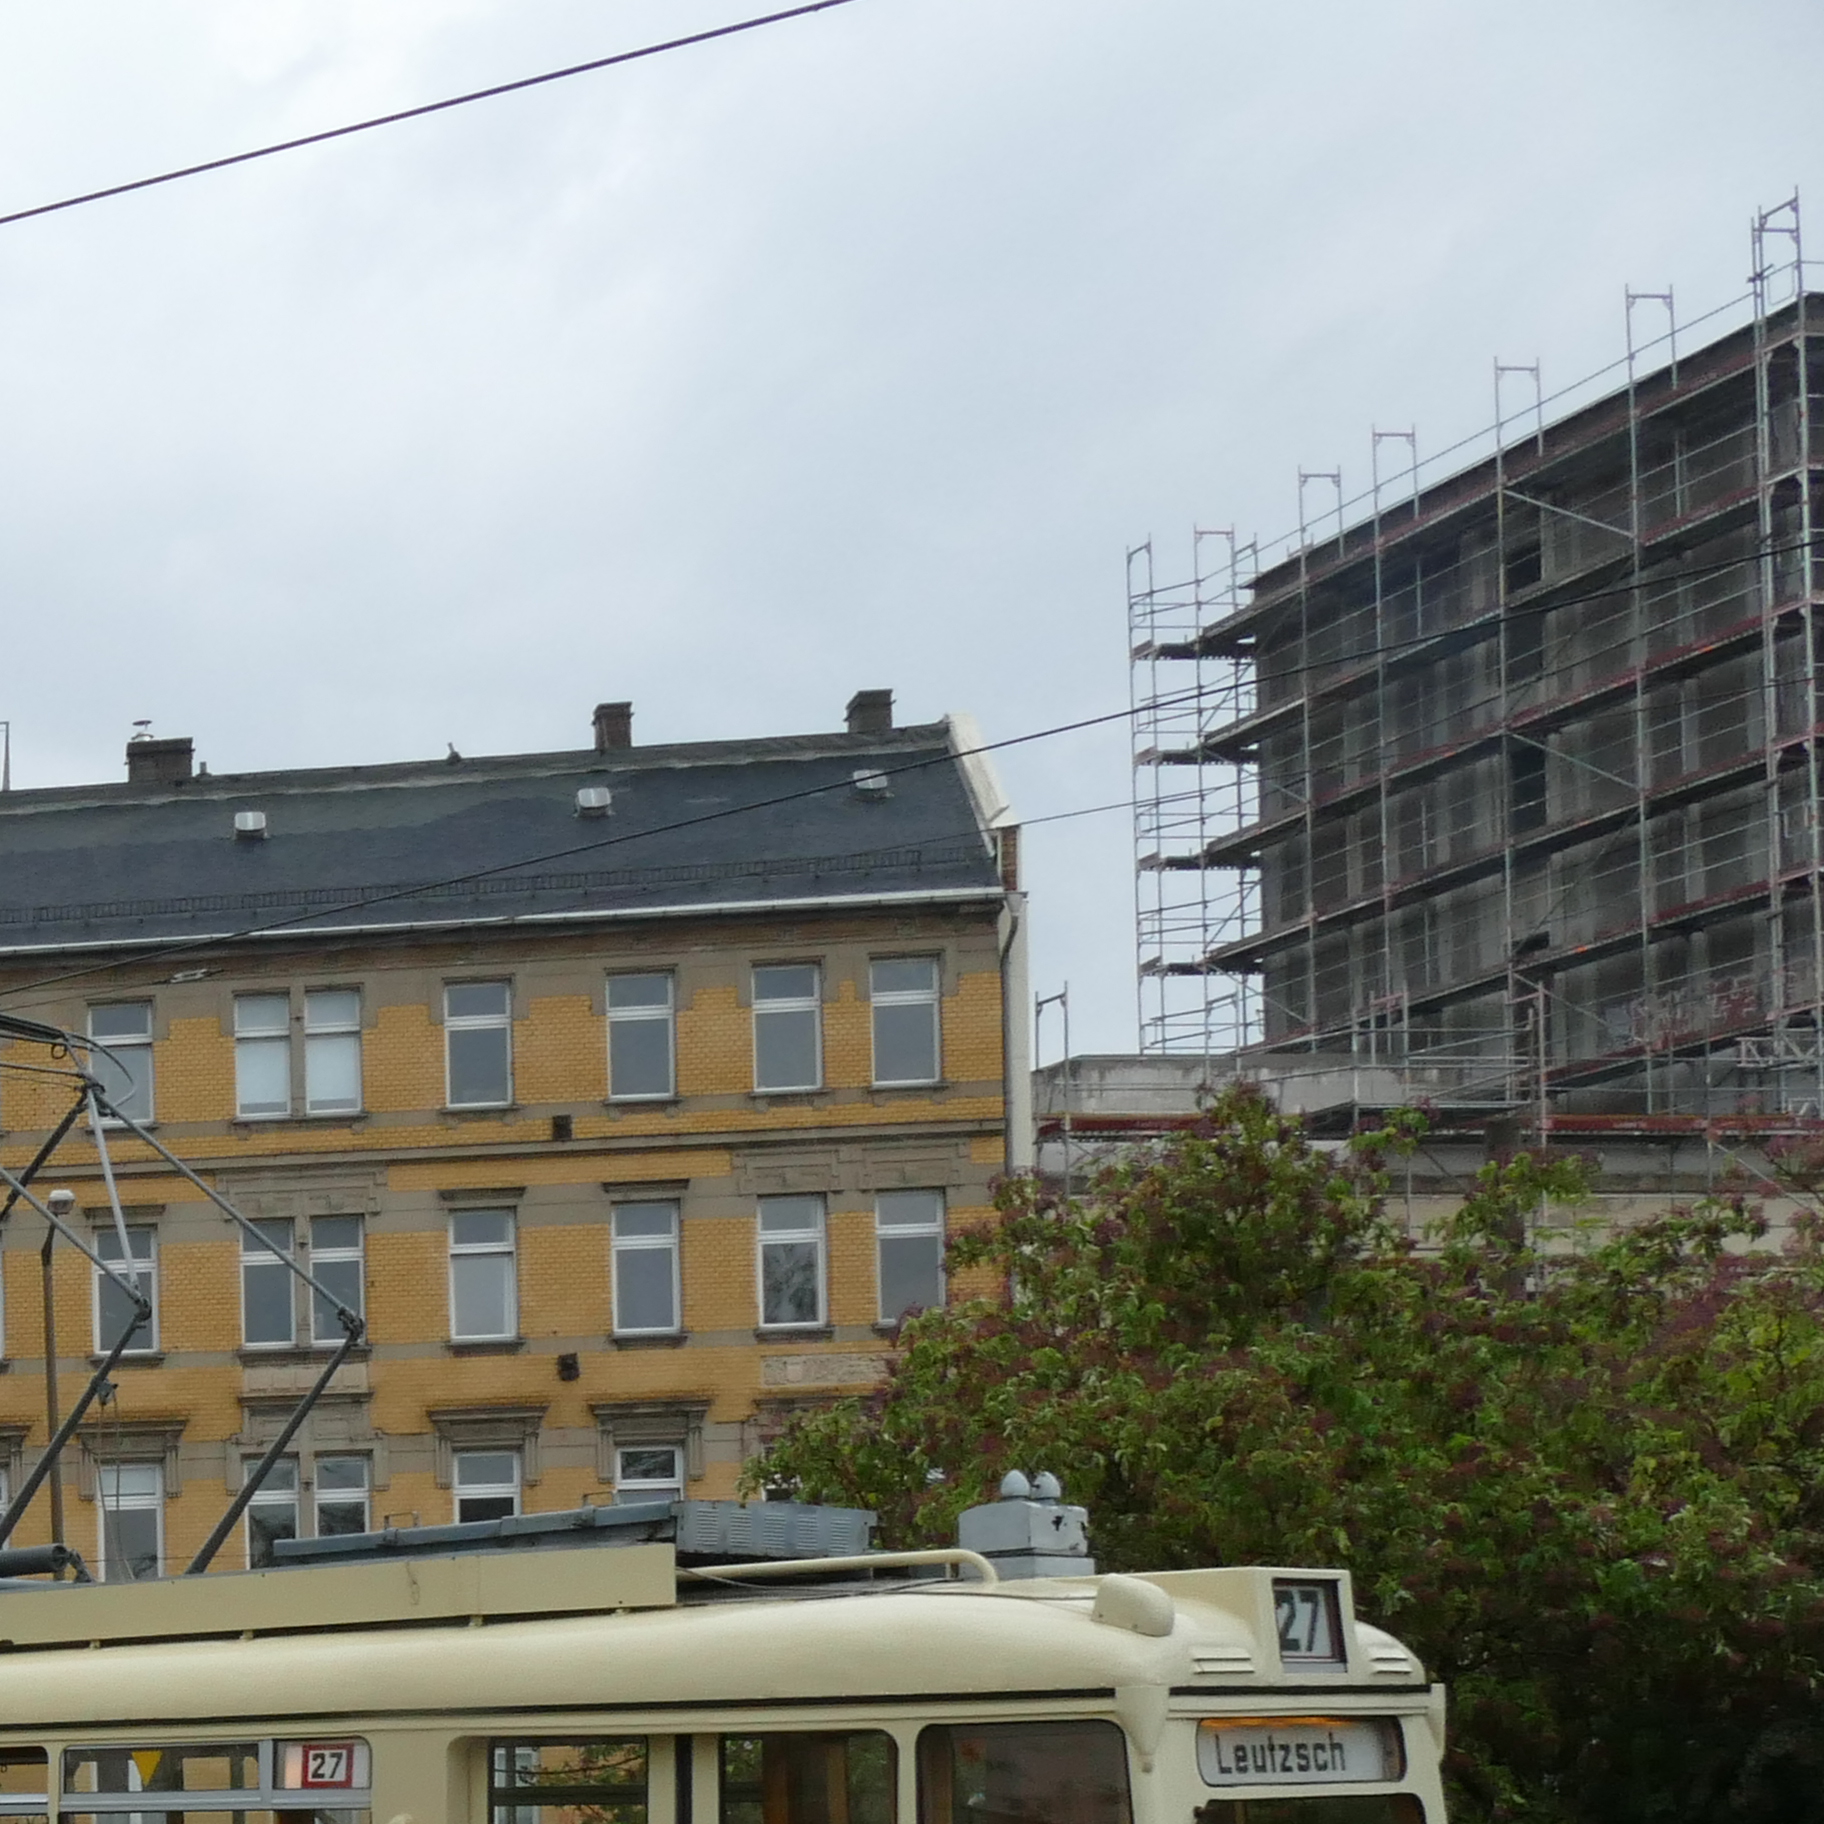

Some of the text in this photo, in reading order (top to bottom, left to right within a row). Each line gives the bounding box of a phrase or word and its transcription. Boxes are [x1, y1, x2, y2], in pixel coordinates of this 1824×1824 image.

[1274, 1589, 1318, 1652] 27
[312, 1752, 343, 1779] 27
[1215, 1731, 1346, 1774] Leutzsch
